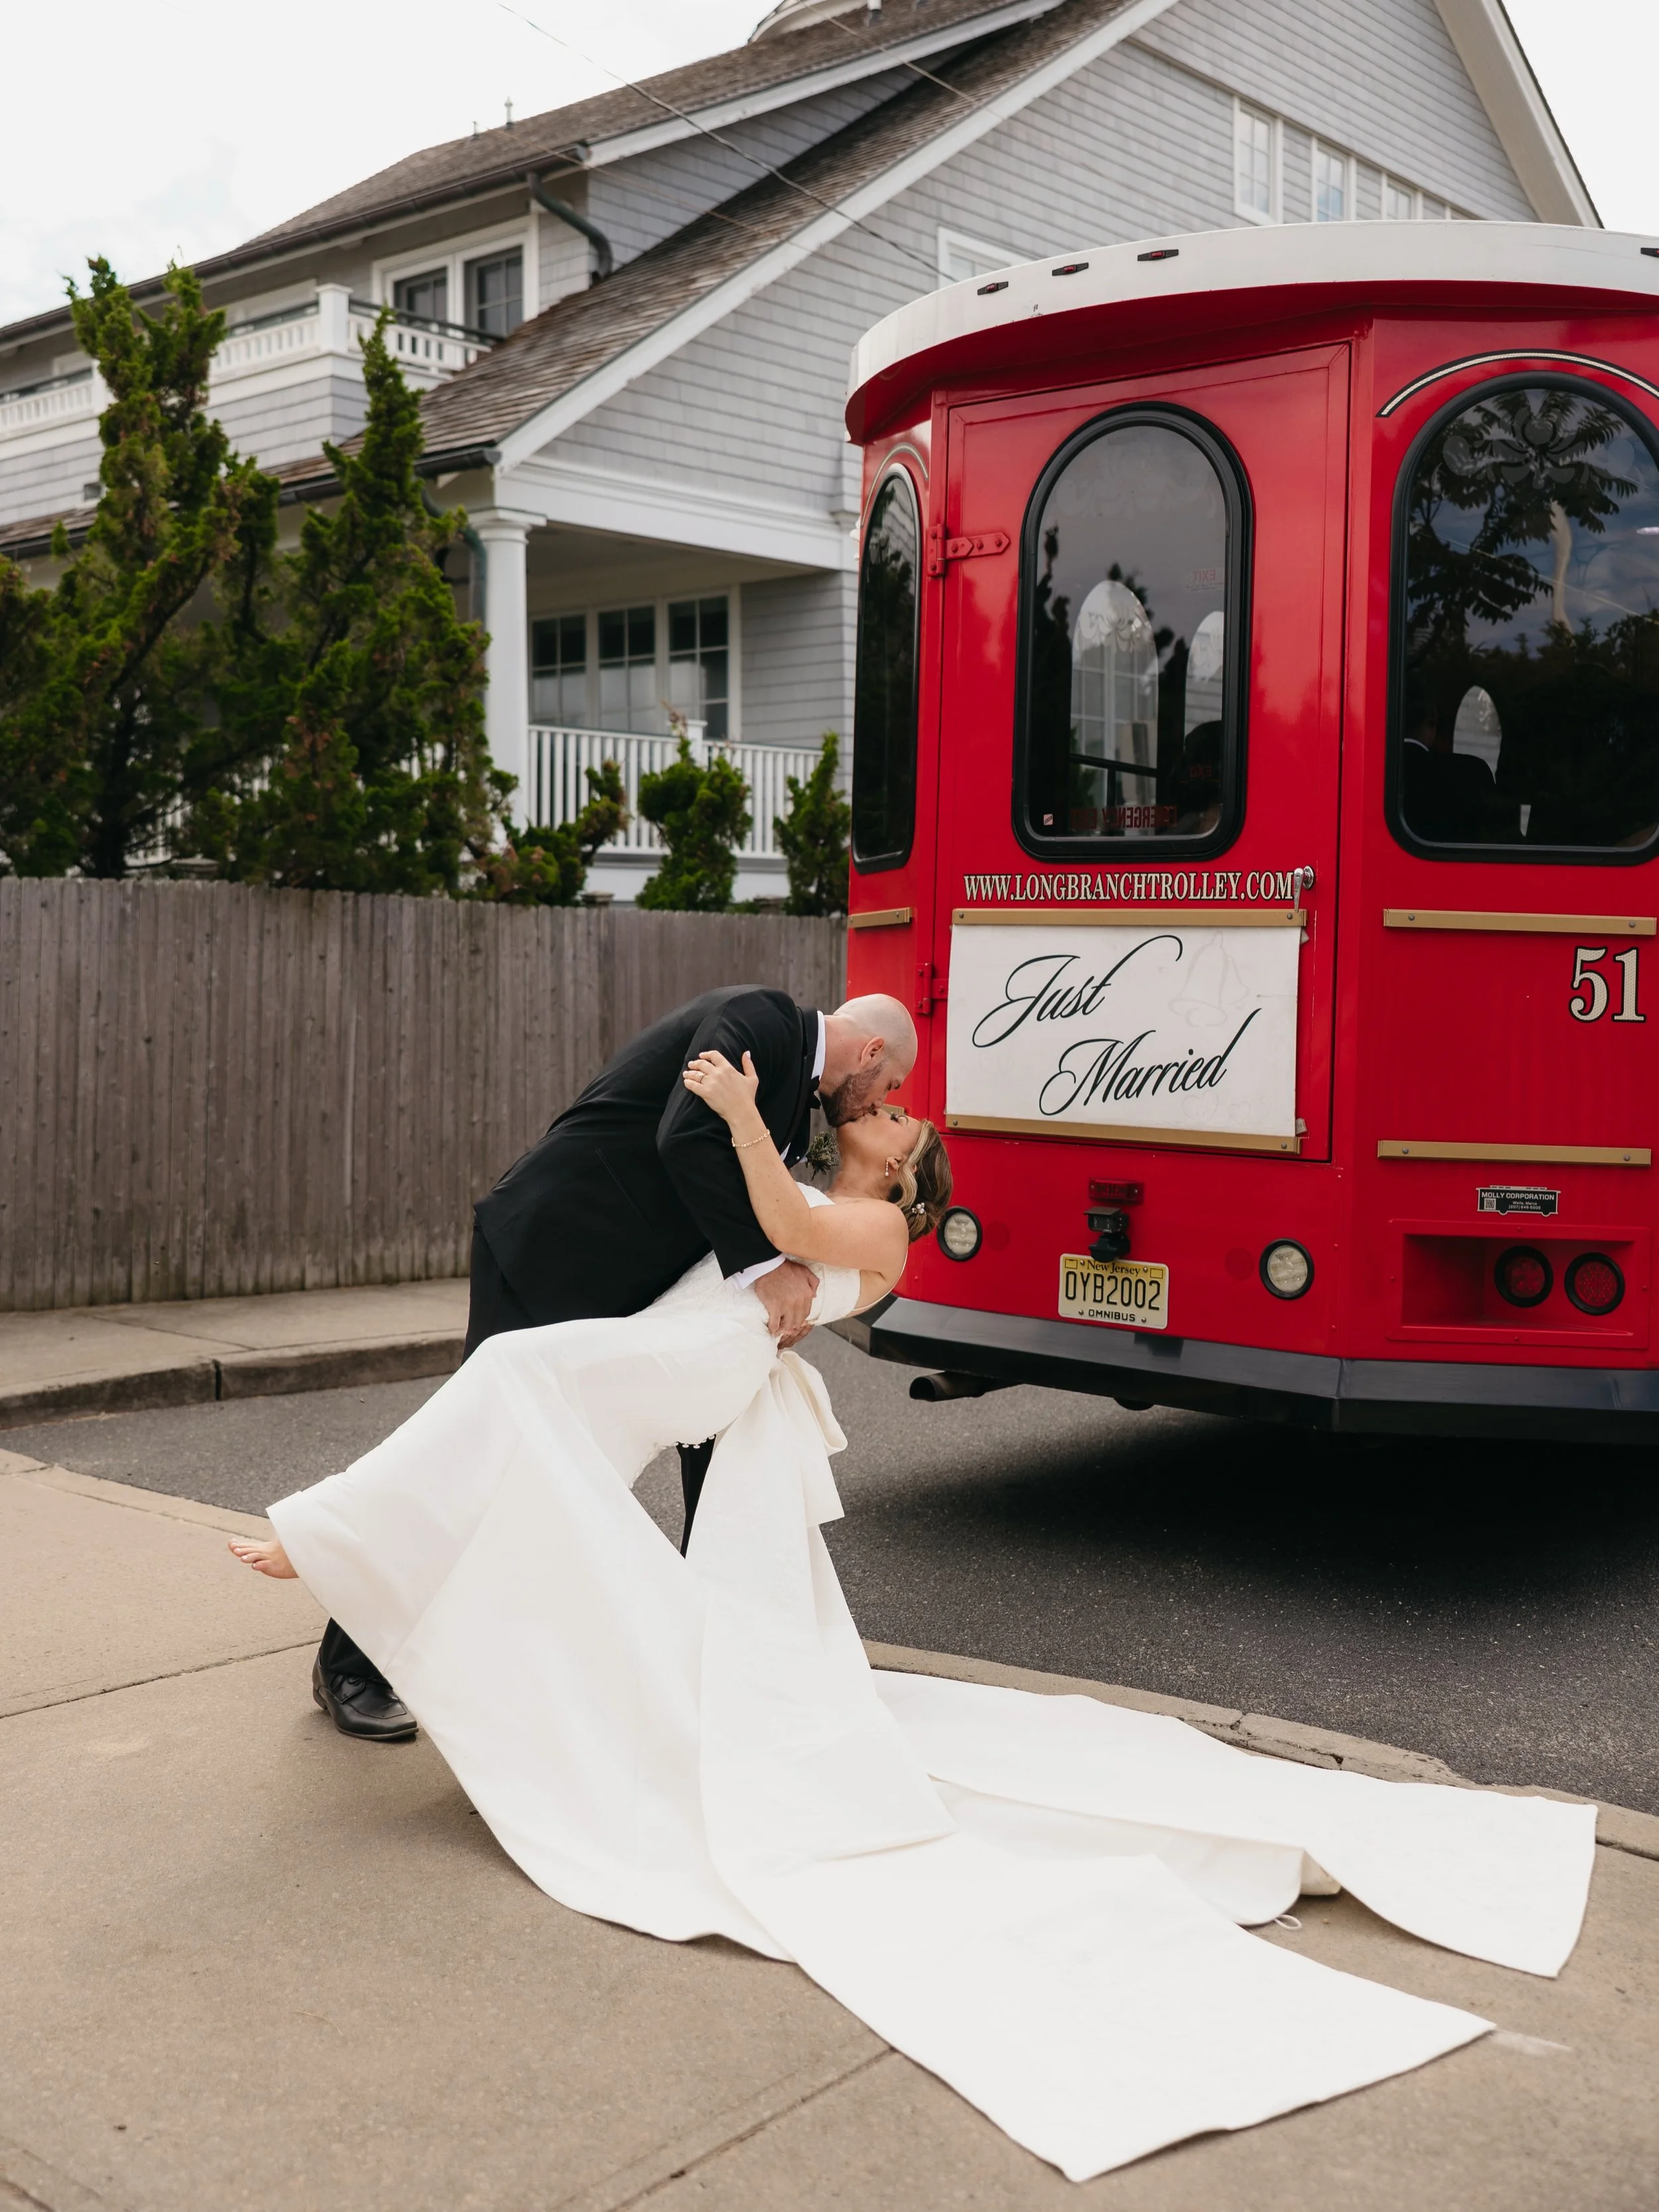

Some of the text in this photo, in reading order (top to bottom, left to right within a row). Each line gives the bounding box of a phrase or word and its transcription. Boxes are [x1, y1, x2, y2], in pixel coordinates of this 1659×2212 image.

[964, 871, 1294, 901] WWW.LONGBRANCHTROLLEY.COM
[972, 934, 1183, 1048] Just
[1569, 946, 1646, 1022] 51
[1039, 1007, 1262, 1116] Married
[1087, 1260, 1141, 1277] New Jersey
[1088, 1309, 1136, 1321] OMNIBUS
